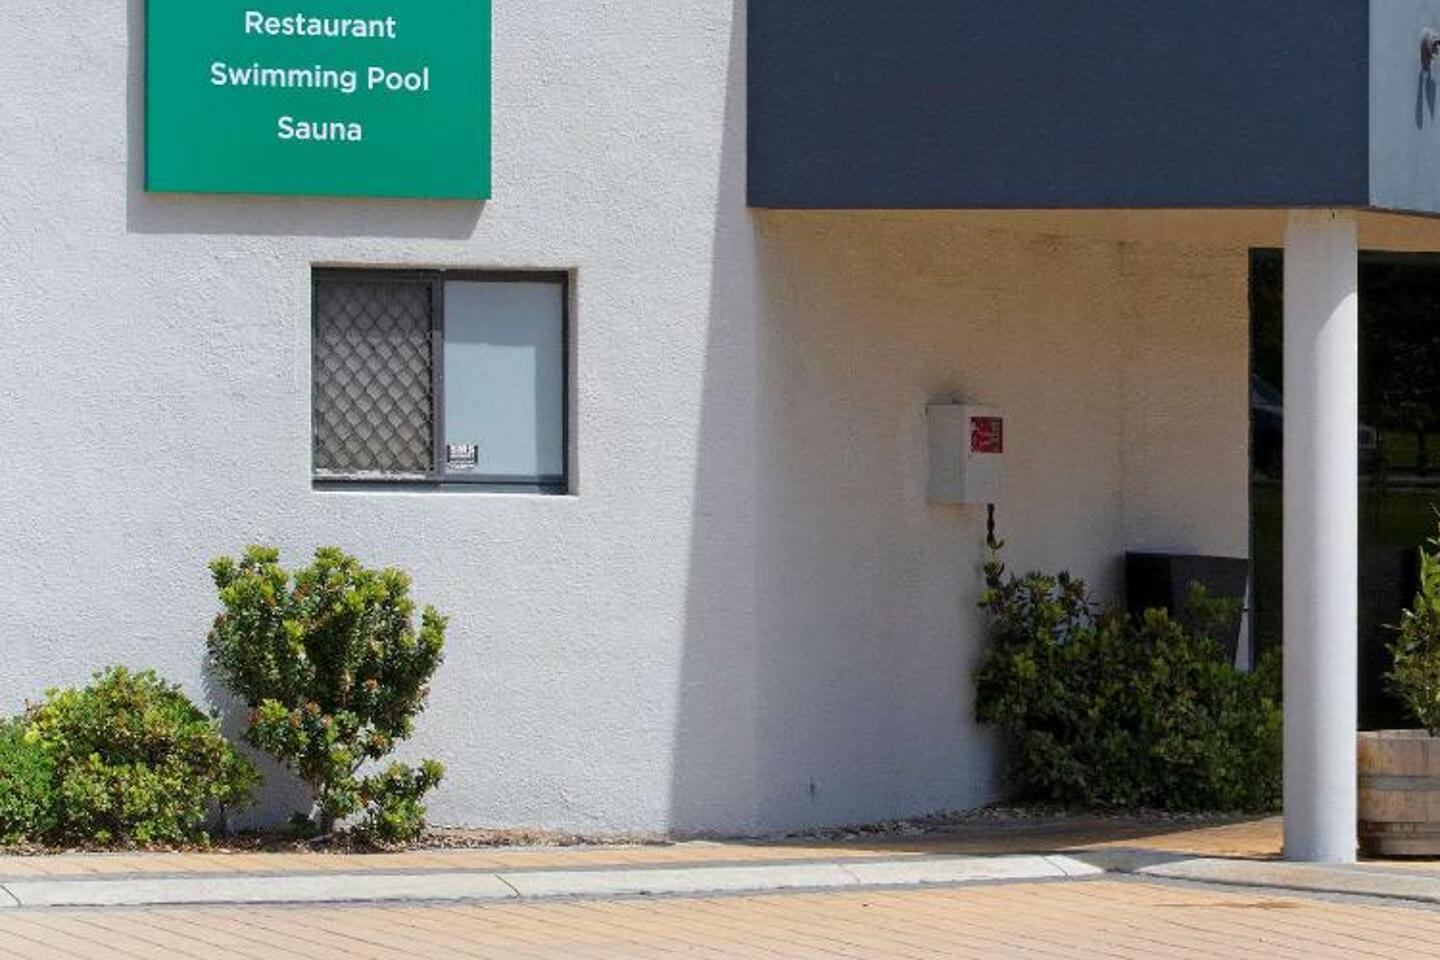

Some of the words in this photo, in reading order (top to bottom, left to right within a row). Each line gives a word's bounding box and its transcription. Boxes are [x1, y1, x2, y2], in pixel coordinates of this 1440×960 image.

[246, 11, 396, 38] Restaurant
[211, 63, 356, 93] Swimming
[368, 67, 428, 90] Pool
[278, 116, 361, 140] Sauna
